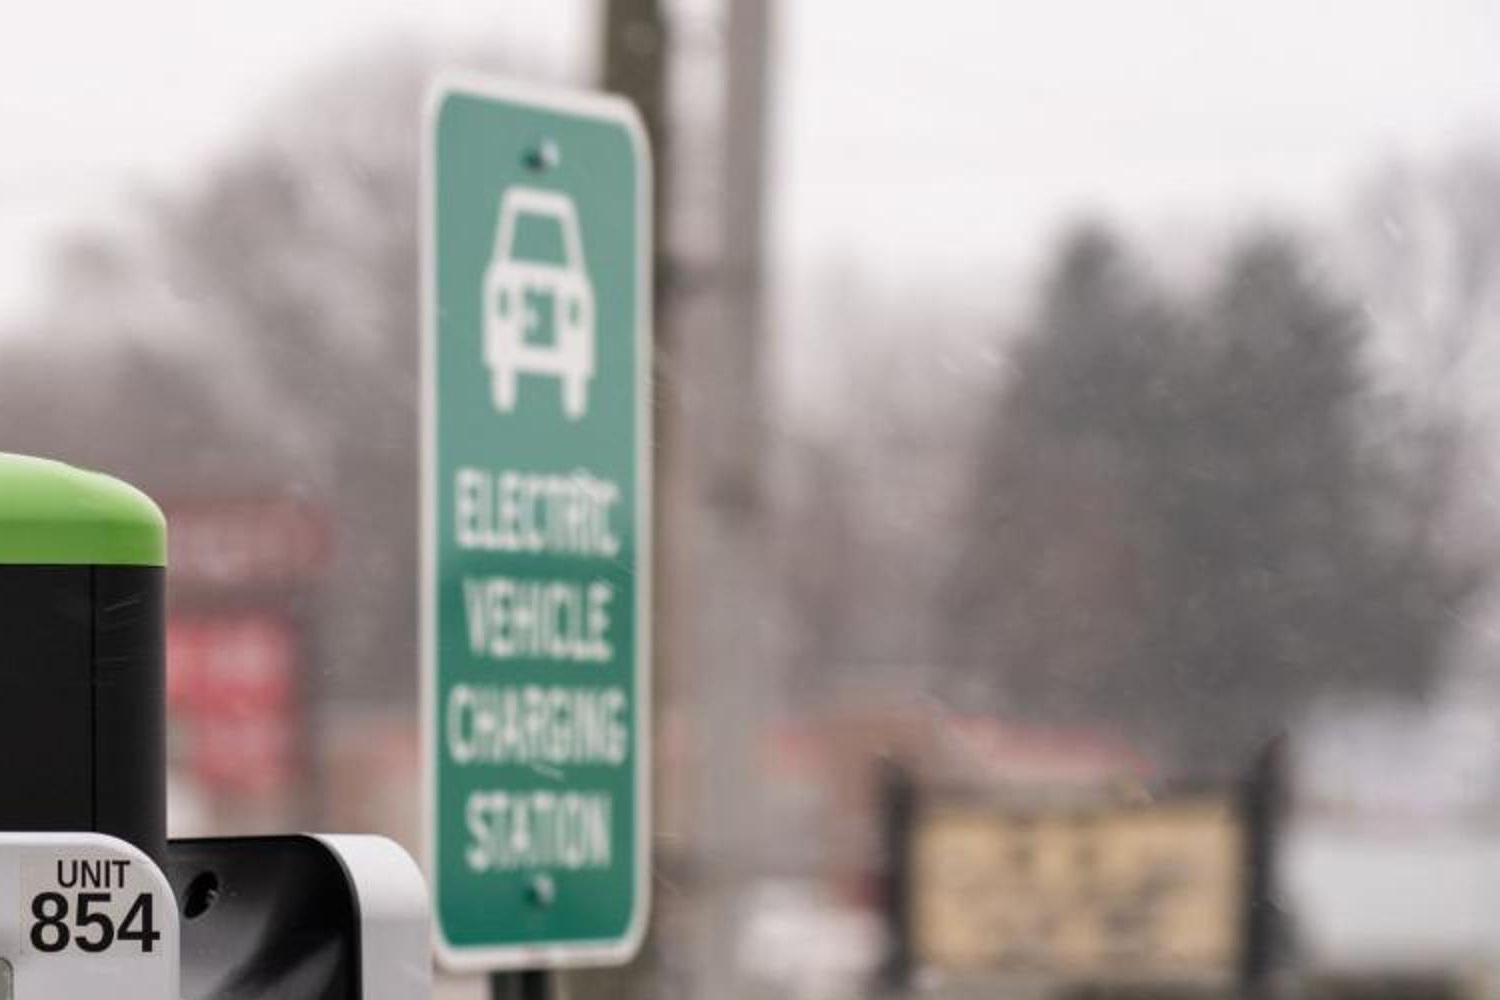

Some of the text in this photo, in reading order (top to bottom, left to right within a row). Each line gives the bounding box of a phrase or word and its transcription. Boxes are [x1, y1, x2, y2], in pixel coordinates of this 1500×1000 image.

[455, 467, 619, 556] ELECTRIC
[464, 577, 614, 663] VEHICLE
[448, 684, 627, 765] CHARGING
[465, 790, 612, 871] STATION
[56, 859, 131, 888] UNIT
[29, 892, 161, 953] 854
